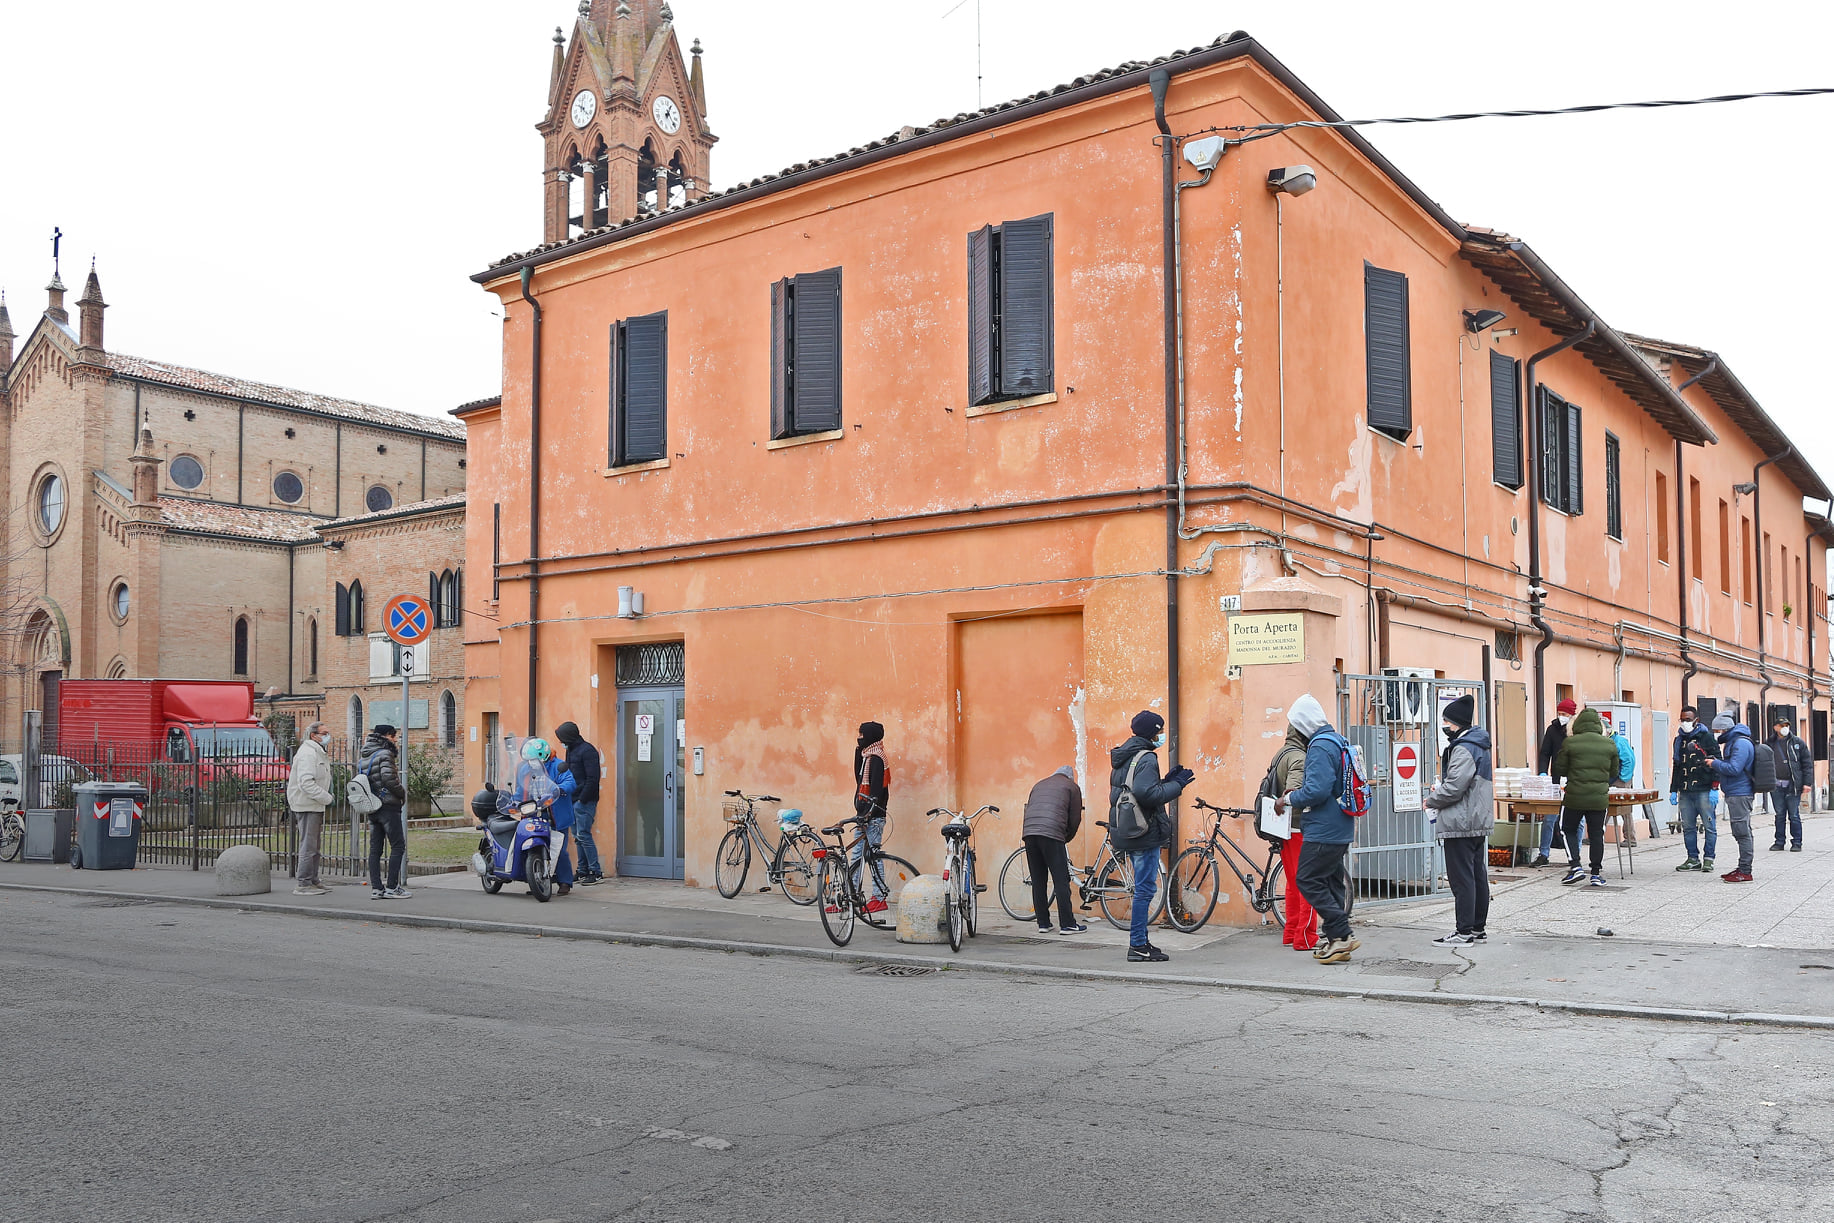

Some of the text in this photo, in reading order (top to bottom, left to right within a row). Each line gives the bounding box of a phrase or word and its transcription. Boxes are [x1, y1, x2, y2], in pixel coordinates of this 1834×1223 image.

[1224, 597, 1237, 608] 117
[1234, 622, 1298, 635] Porta Aperta
